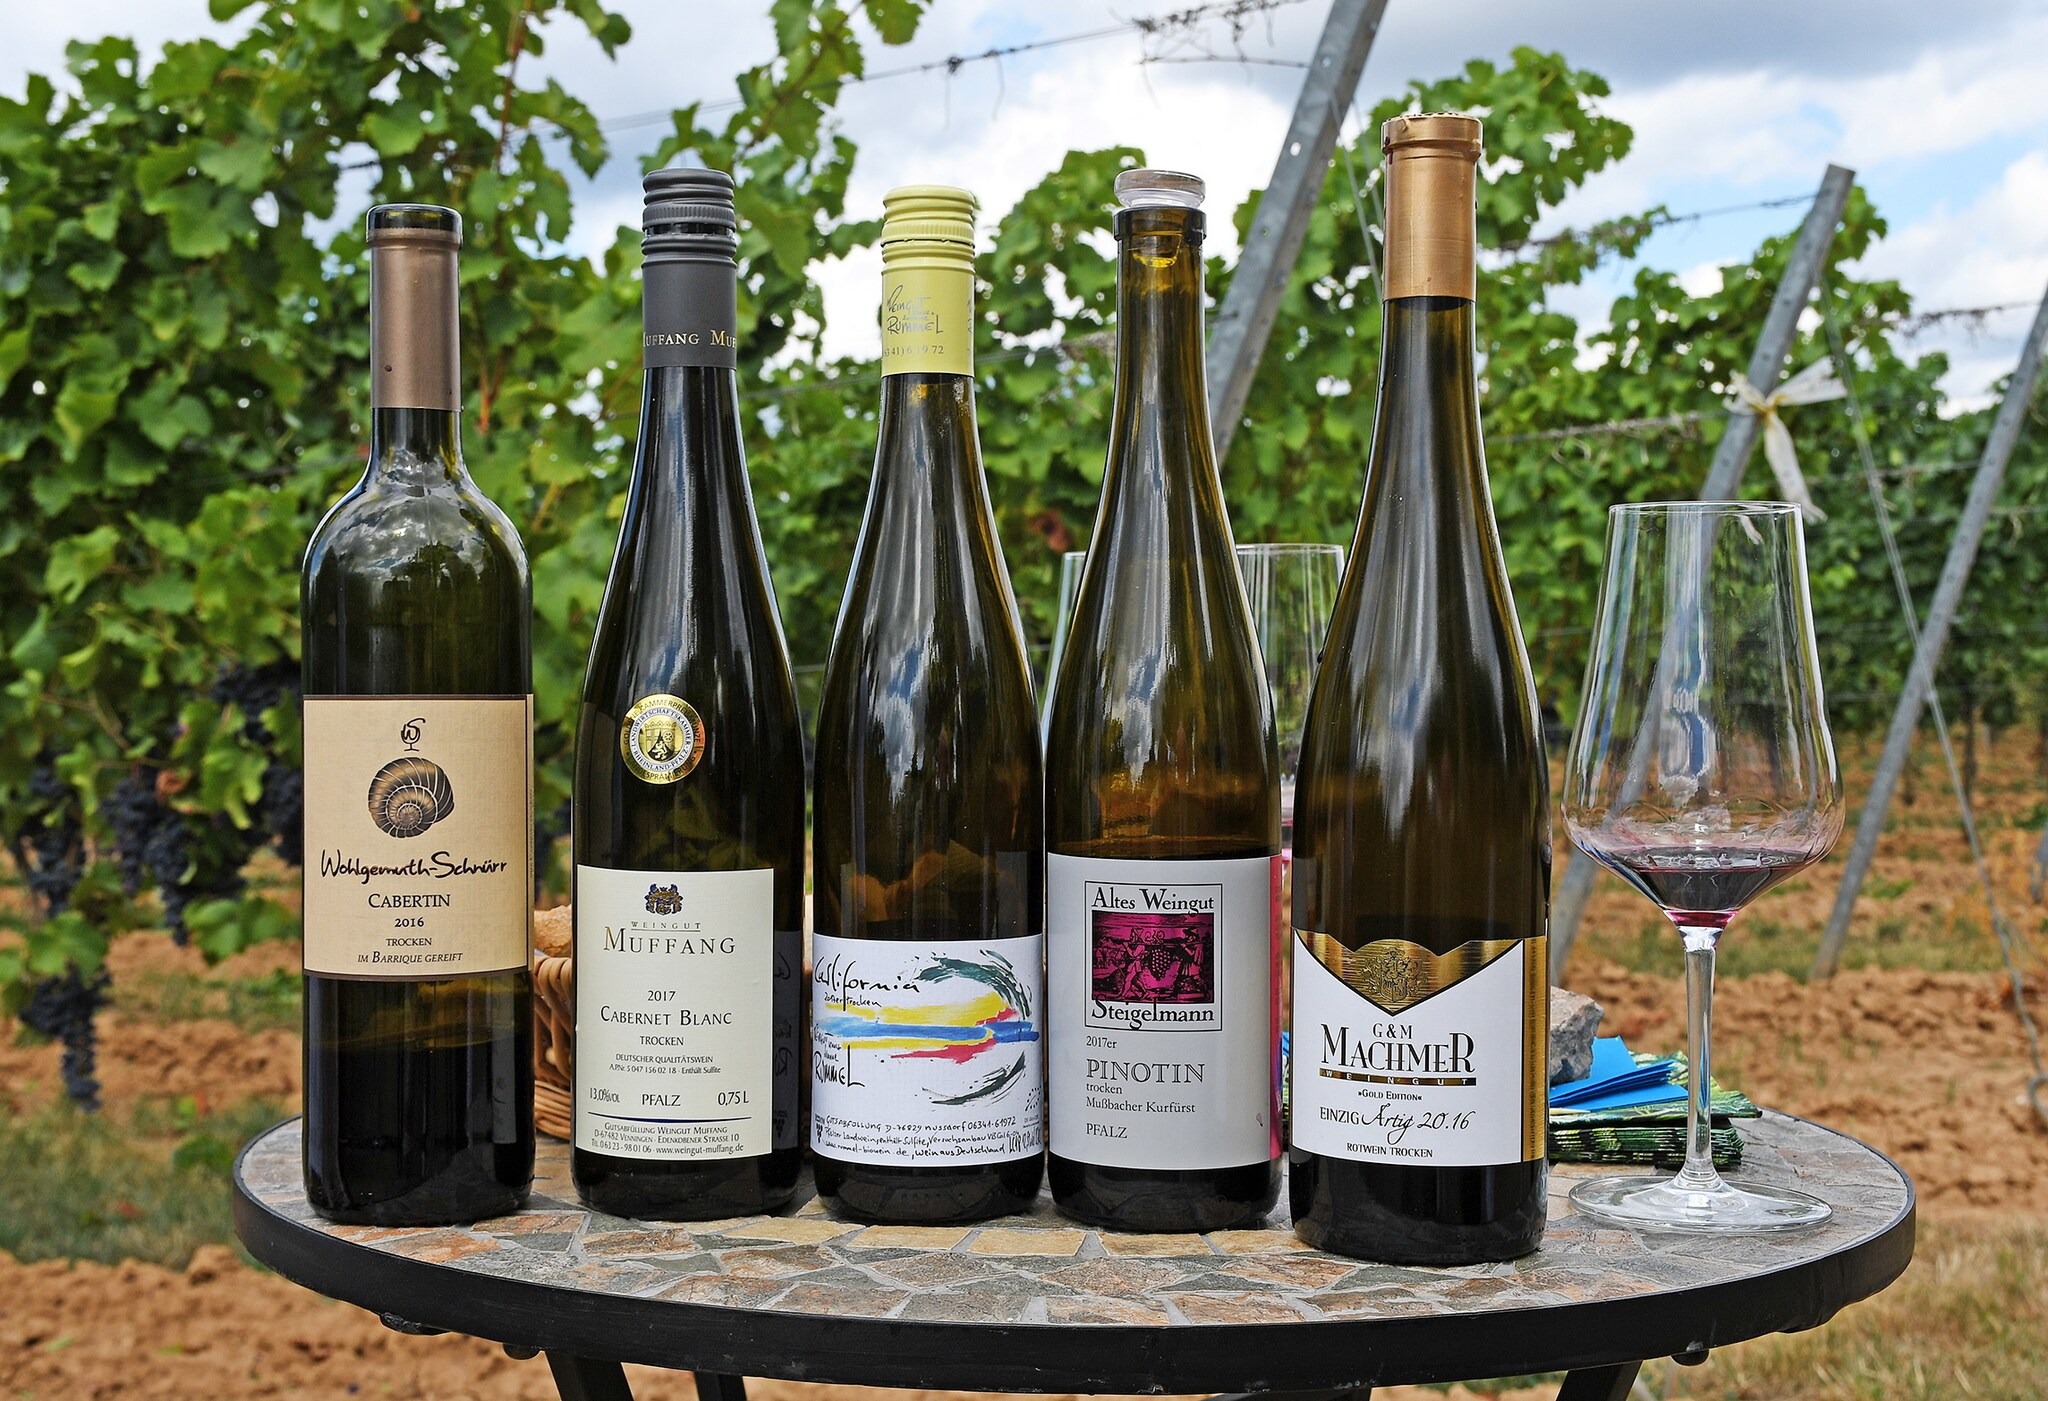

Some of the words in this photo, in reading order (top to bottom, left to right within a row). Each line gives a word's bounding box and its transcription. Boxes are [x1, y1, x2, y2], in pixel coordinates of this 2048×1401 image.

[321, 849, 507, 884] Wohlgemuth-Schnürr
[368, 893, 450, 908] CABERTIN
[1091, 887, 1135, 910] Altes
[1139, 888, 1214, 915] Weingut
[394, 917, 425, 928] 2016
[631, 921, 701, 929] WEINGUT
[386, 937, 432, 946] TROCKEN
[603, 926, 736, 955] MUFFANG
[357, 954, 369, 963] IM
[372, 951, 422, 965] BARRIQUE
[425, 953, 463, 963] GEREIFT
[647, 990, 676, 1001] 2017
[600, 1006, 671, 1026] CABERNET
[680, 1009, 732, 1026] BLANC
[1091, 995, 1214, 1030] Steigelmann
[1373, 1023, 1383, 1039] G
[1386, 1024, 1397, 1039] &
[1400, 1024, 1413, 1040] M
[640, 1036, 684, 1046] TROCKEN
[1086, 1035, 1117, 1049] 2017er
[1321, 1023, 1475, 1074] MACHMER
[616, 1053, 654, 1063] DEUTSCHER
[655, 1055, 713, 1065] QUALITÄTSWEIN
[703, 1065, 721, 1074] Sulfite
[1086, 1058, 1205, 1084] PINOTIN
[1325, 1070, 1468, 1086] WEINGUT
[1086, 1082, 1122, 1095] trocken
[642, 1094, 681, 1106] PFALZ
[718, 1090, 741, 1106] 0,75
[1086, 1096, 1142, 1112] Mußbacher
[1146, 1101, 1196, 1114] Kurfürst
[1416, 1110, 1476, 1130] 20.16
[605, 1122, 655, 1134] GUTSABFÜLLUNG
[658, 1126, 691, 1134] WEINGUT
[694, 1126, 727, 1134] MUFFANG
[1086, 1123, 1128, 1139] PFALZ
[620, 1133, 653, 1142] VENNINGEN
[658, 1135, 702, 1143] EDENKOBENER
[704, 1135, 729, 1143] STRASSE
[731, 1133, 740, 1141] 10
[656, 1143, 744, 1156] www.weingut-muffang.de
[1346, 1143, 1387, 1155] ROTWEIN
[1389, 1145, 1433, 1158] TROCKEN
